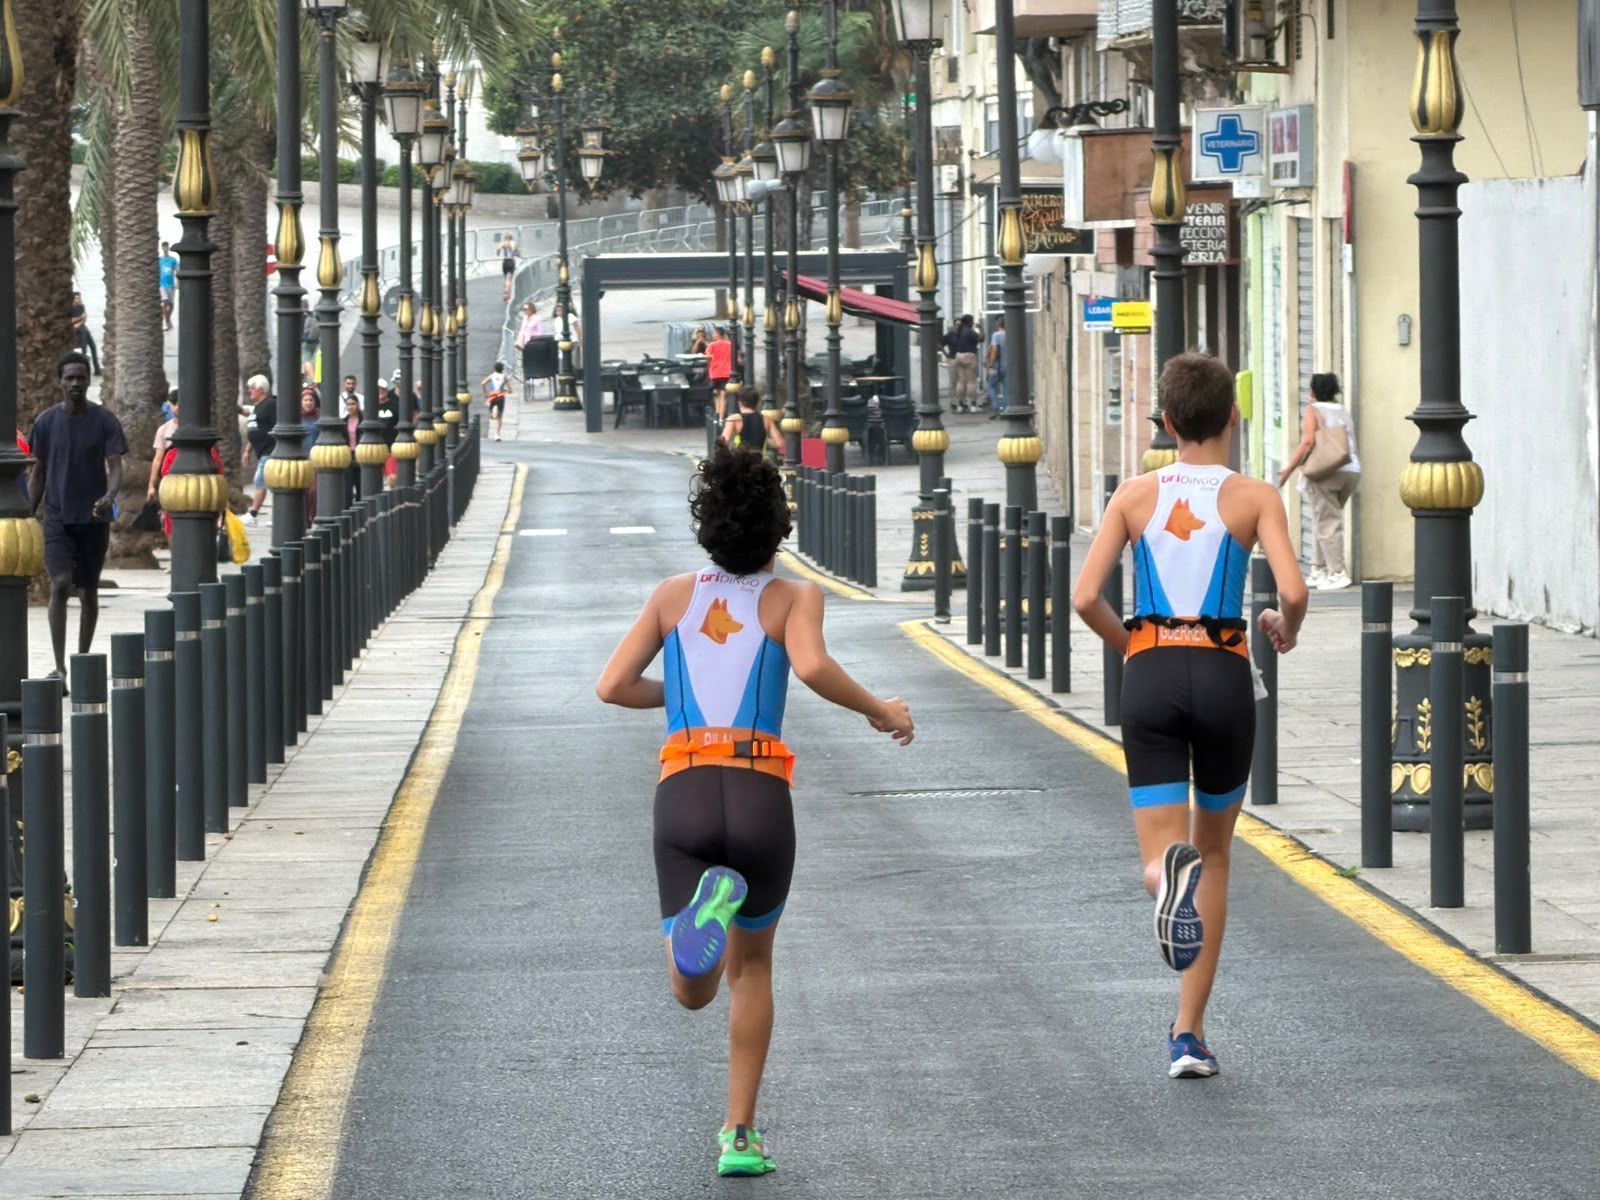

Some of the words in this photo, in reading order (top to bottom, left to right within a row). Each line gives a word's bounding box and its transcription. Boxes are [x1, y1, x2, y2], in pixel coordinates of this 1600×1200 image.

[1185, 202, 1225, 215] VENIR
[1183, 215, 1226, 227] TERIA
[1179, 227, 1227, 239] FECCION
[1088, 306, 1111, 315] LEBAR
[1160, 625, 1209, 640] GUERRER
